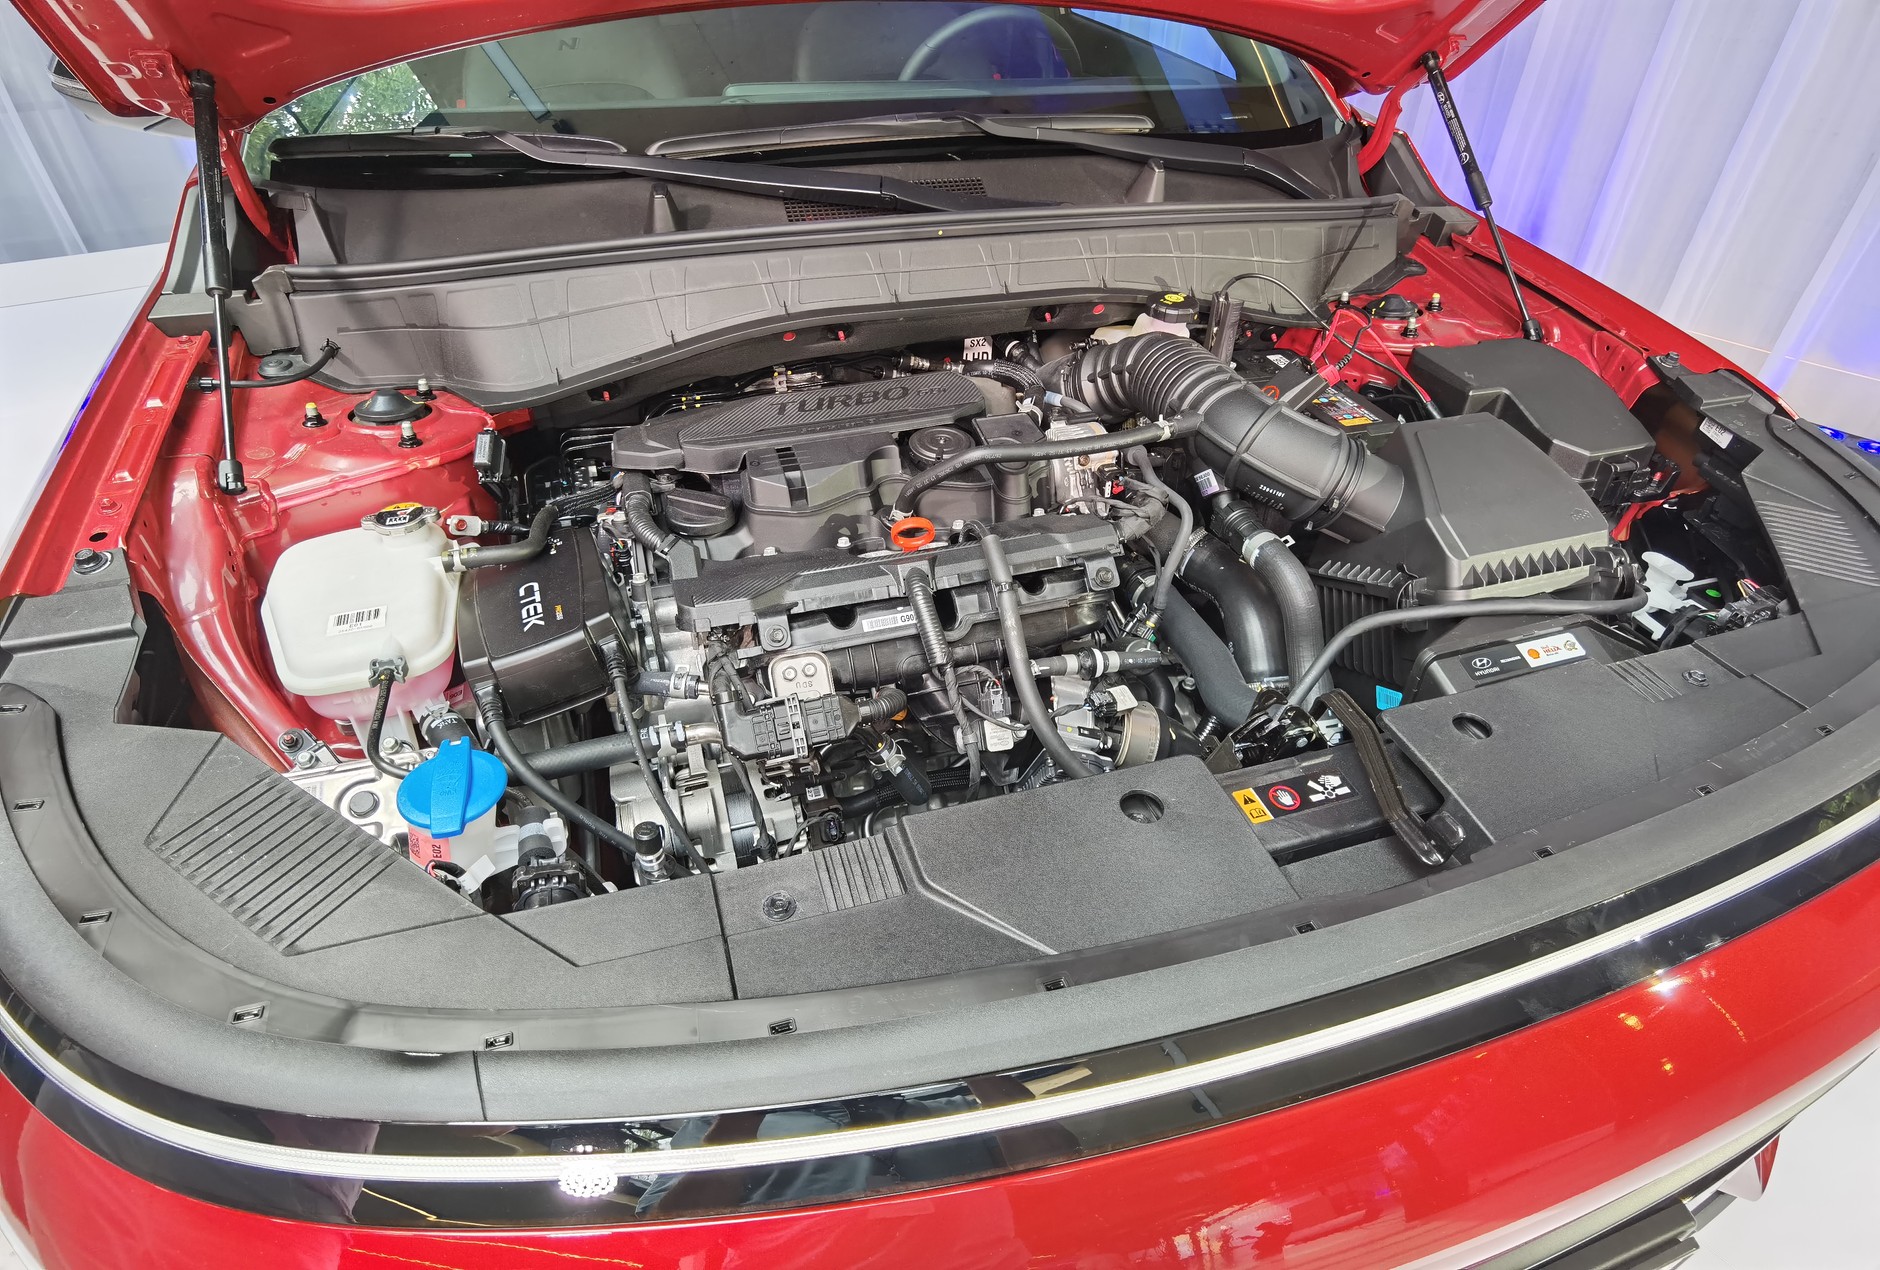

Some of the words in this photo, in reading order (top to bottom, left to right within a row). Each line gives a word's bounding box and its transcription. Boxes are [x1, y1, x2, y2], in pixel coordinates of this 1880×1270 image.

[970, 337, 987, 347] SX2
[771, 386, 909, 416] TURBO
[519, 581, 545, 632] CTEK
[900, 613, 915, 623] G90
[1475, 666, 1500, 676] HYUNDAI
[437, 717, 459, 729] TANK
[432, 844, 441, 859] E02
